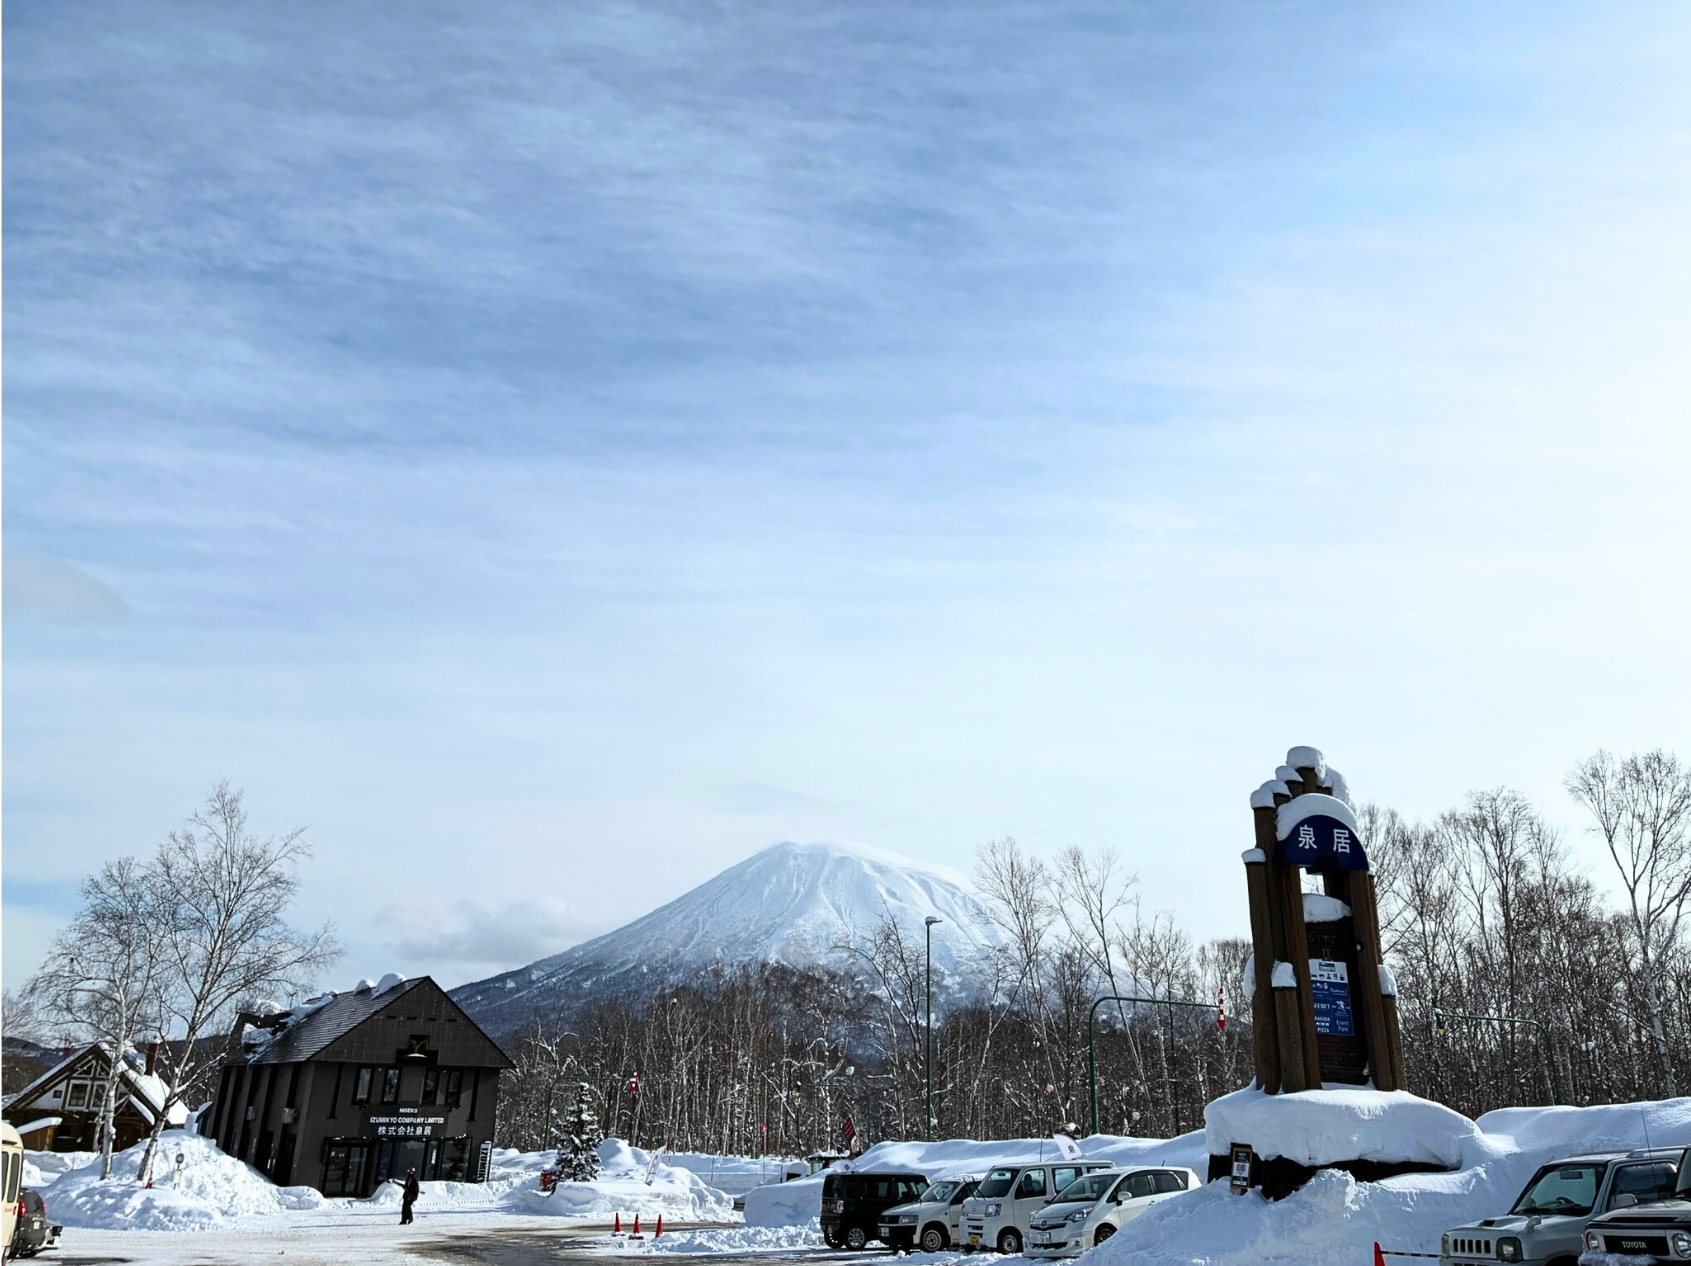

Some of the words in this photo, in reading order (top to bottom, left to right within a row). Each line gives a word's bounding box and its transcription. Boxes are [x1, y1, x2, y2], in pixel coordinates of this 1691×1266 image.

[1298, 824, 1351, 854] 泉居
[370, 1116, 397, 1124] IZUMIKYO
[377, 1125, 432, 1136] 株式会社泉居
[1621, 1241, 1647, 1249] TOYOTA
